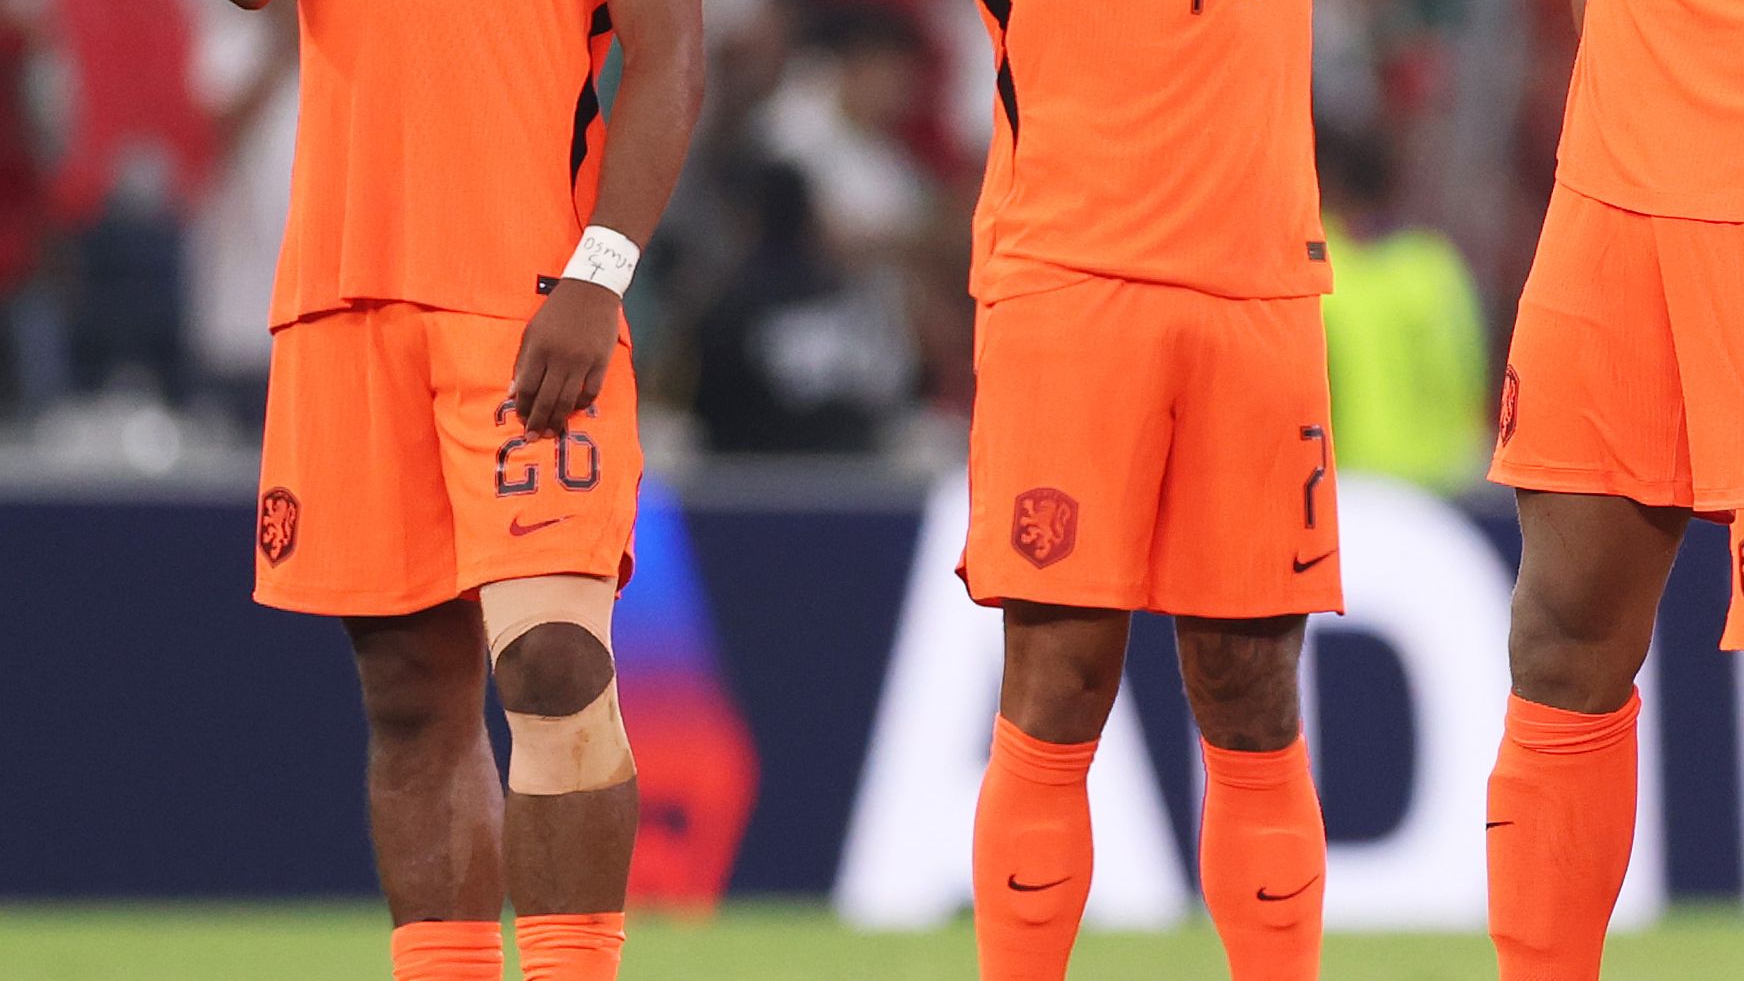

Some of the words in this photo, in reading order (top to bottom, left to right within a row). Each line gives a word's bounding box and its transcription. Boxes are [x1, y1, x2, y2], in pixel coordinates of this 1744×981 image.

[495, 399, 600, 498] 26
[1299, 425, 1327, 530] 7
[832, 469, 1668, 933] AD
